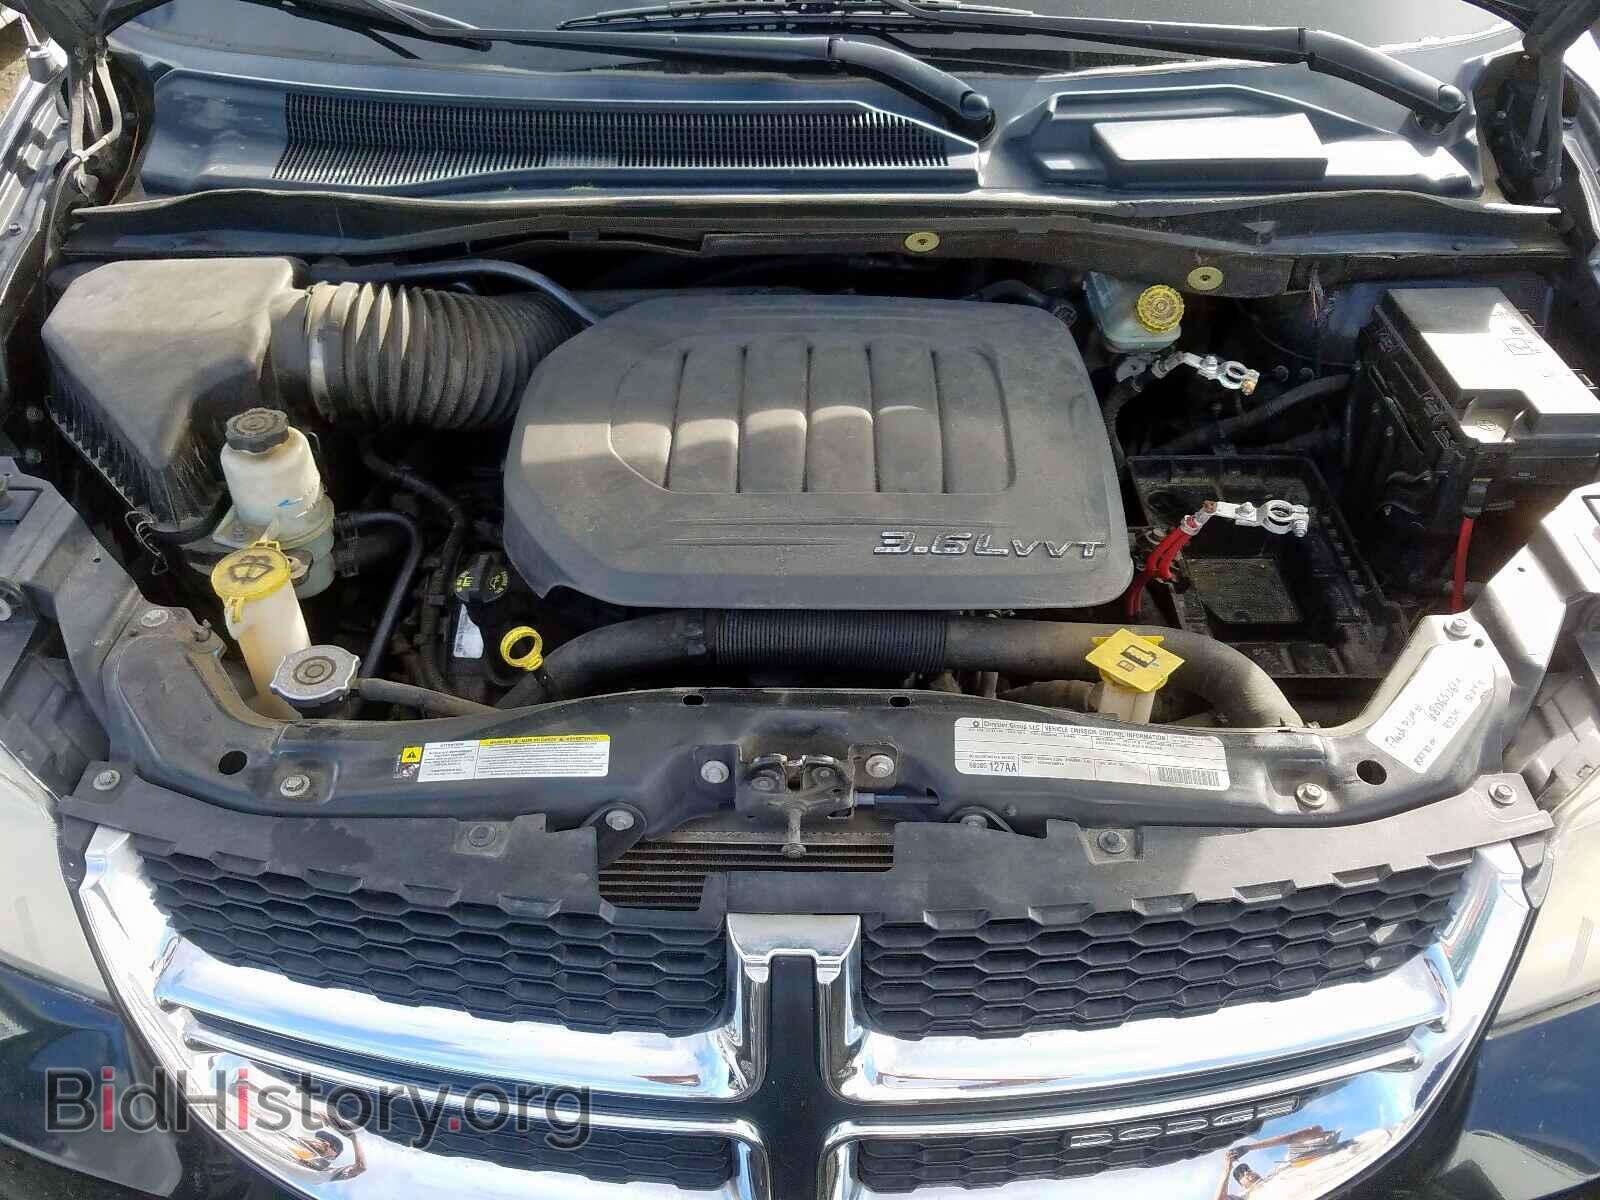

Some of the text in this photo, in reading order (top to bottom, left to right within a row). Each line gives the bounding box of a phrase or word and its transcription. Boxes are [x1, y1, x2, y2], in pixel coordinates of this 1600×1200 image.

[1044, 725, 1068, 733] VEHICLE
[1070, 727, 1098, 736] EMISSION
[1099, 730, 1124, 738] CONTROL
[1126, 732, 1166, 741] INFORMATION
[989, 761, 1017, 773] 127AA
[1069, 1099, 1295, 1147] DODGE
